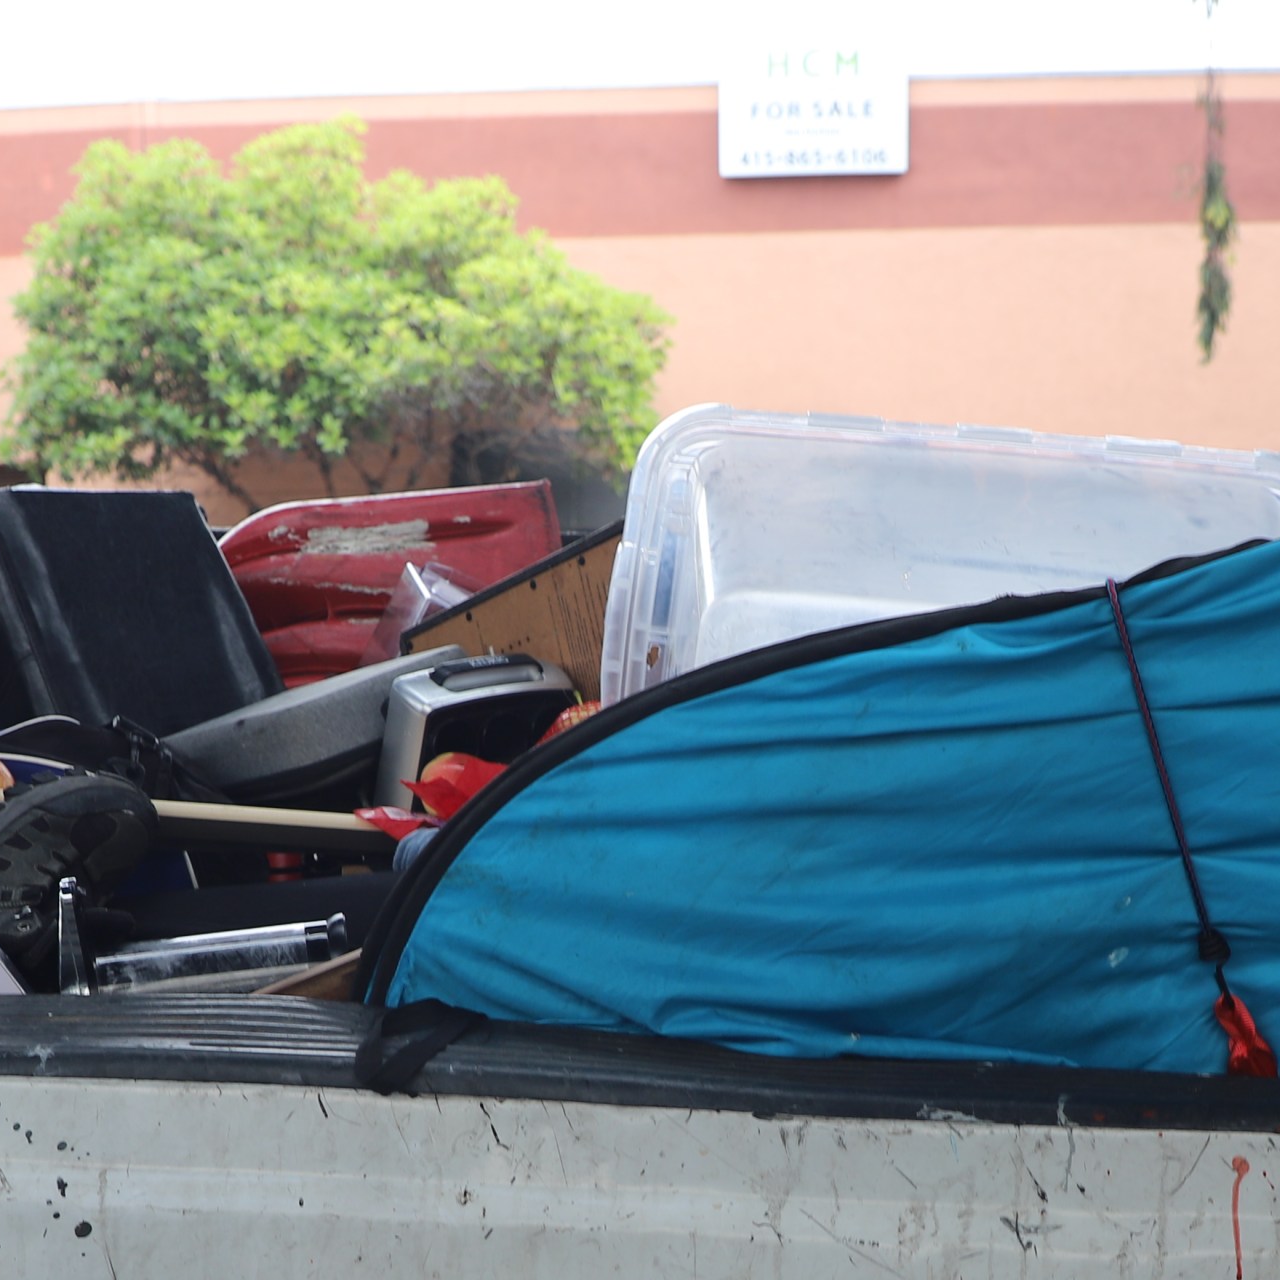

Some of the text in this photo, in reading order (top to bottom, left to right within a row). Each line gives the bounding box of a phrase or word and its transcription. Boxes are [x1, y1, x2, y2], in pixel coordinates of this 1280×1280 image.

[767, 49, 859, 78] HCM
[750, 98, 873, 120] FOR SALE
